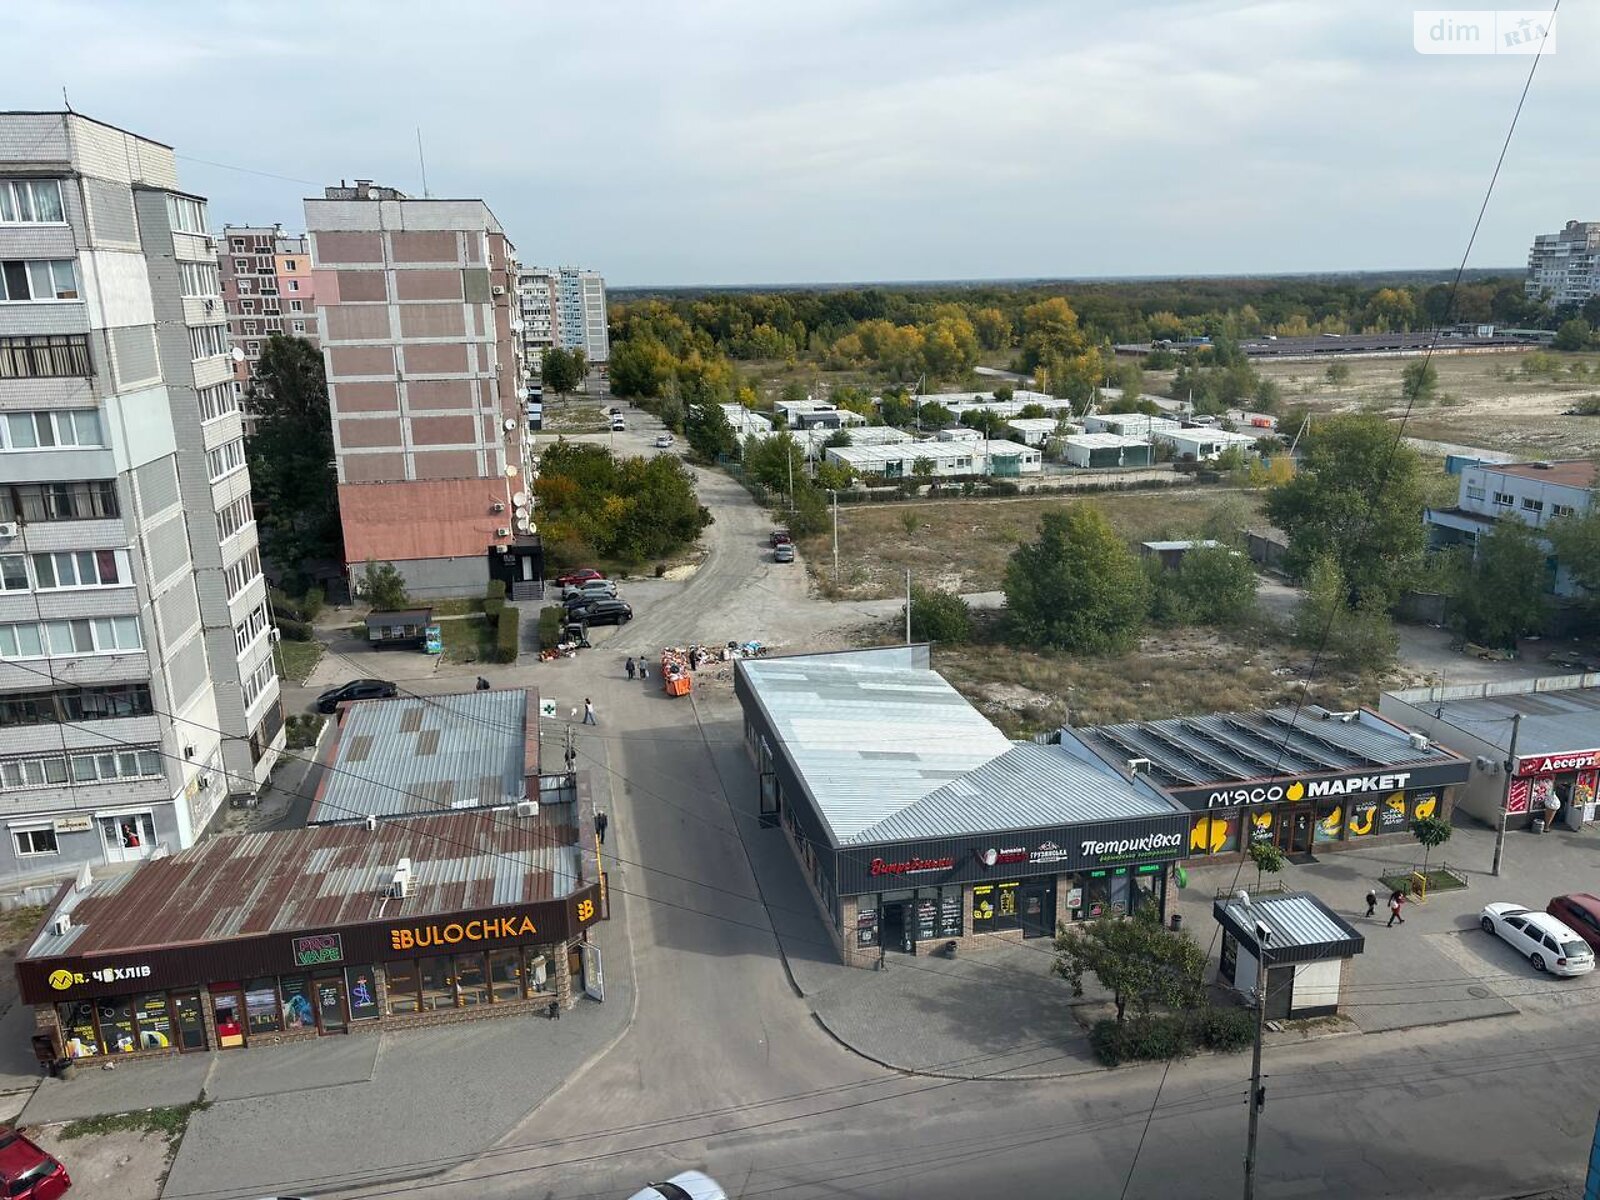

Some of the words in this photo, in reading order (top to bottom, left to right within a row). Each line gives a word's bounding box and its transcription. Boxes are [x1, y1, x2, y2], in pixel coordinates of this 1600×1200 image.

[1307, 772, 1411, 797] МАРКЕТ
[1081, 833, 1181, 857] Петриківка
[299, 936, 336, 951] PRO
[398, 915, 537, 948] BULOCHKA
[298, 947, 340, 964] VAPE
